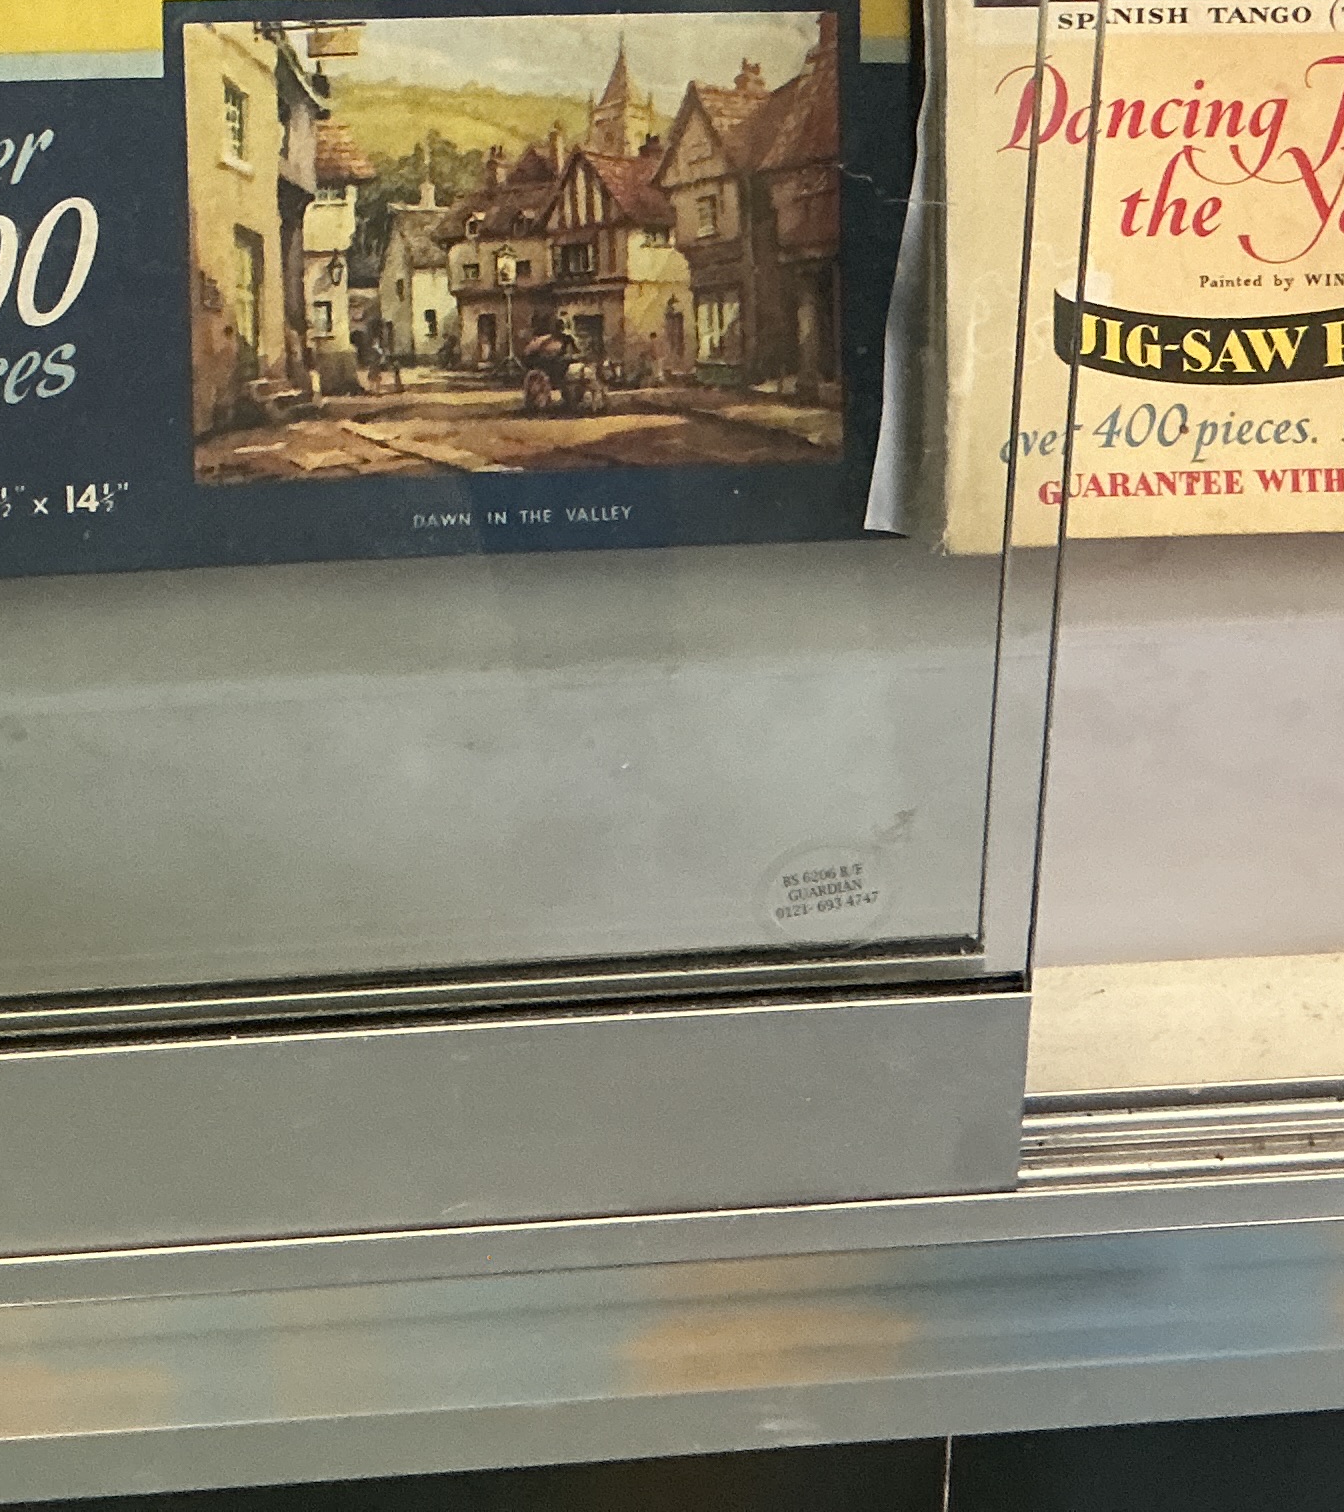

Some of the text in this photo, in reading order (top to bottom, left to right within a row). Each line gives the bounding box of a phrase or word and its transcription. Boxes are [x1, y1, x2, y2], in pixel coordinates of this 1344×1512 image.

[1206, 5, 1313, 25] TANGO
[994, 54, 1296, 185] Dancing
[1119, 146, 1223, 238] the
[1198, 274, 1263, 289] Painted
[1274, 274, 1295, 292] by
[1080, 312, 1309, 374] JIG-SAW
[1092, 402, 1189, 449] 400
[1191, 411, 1318, 463] pieces.
[1038, 468, 1245, 506] GUARANTEE
[32, 497, 49, 515] x
[412, 505, 634, 529] DAWN IN THE VALLEY
[788, 878, 863, 902] GUARDIAN
